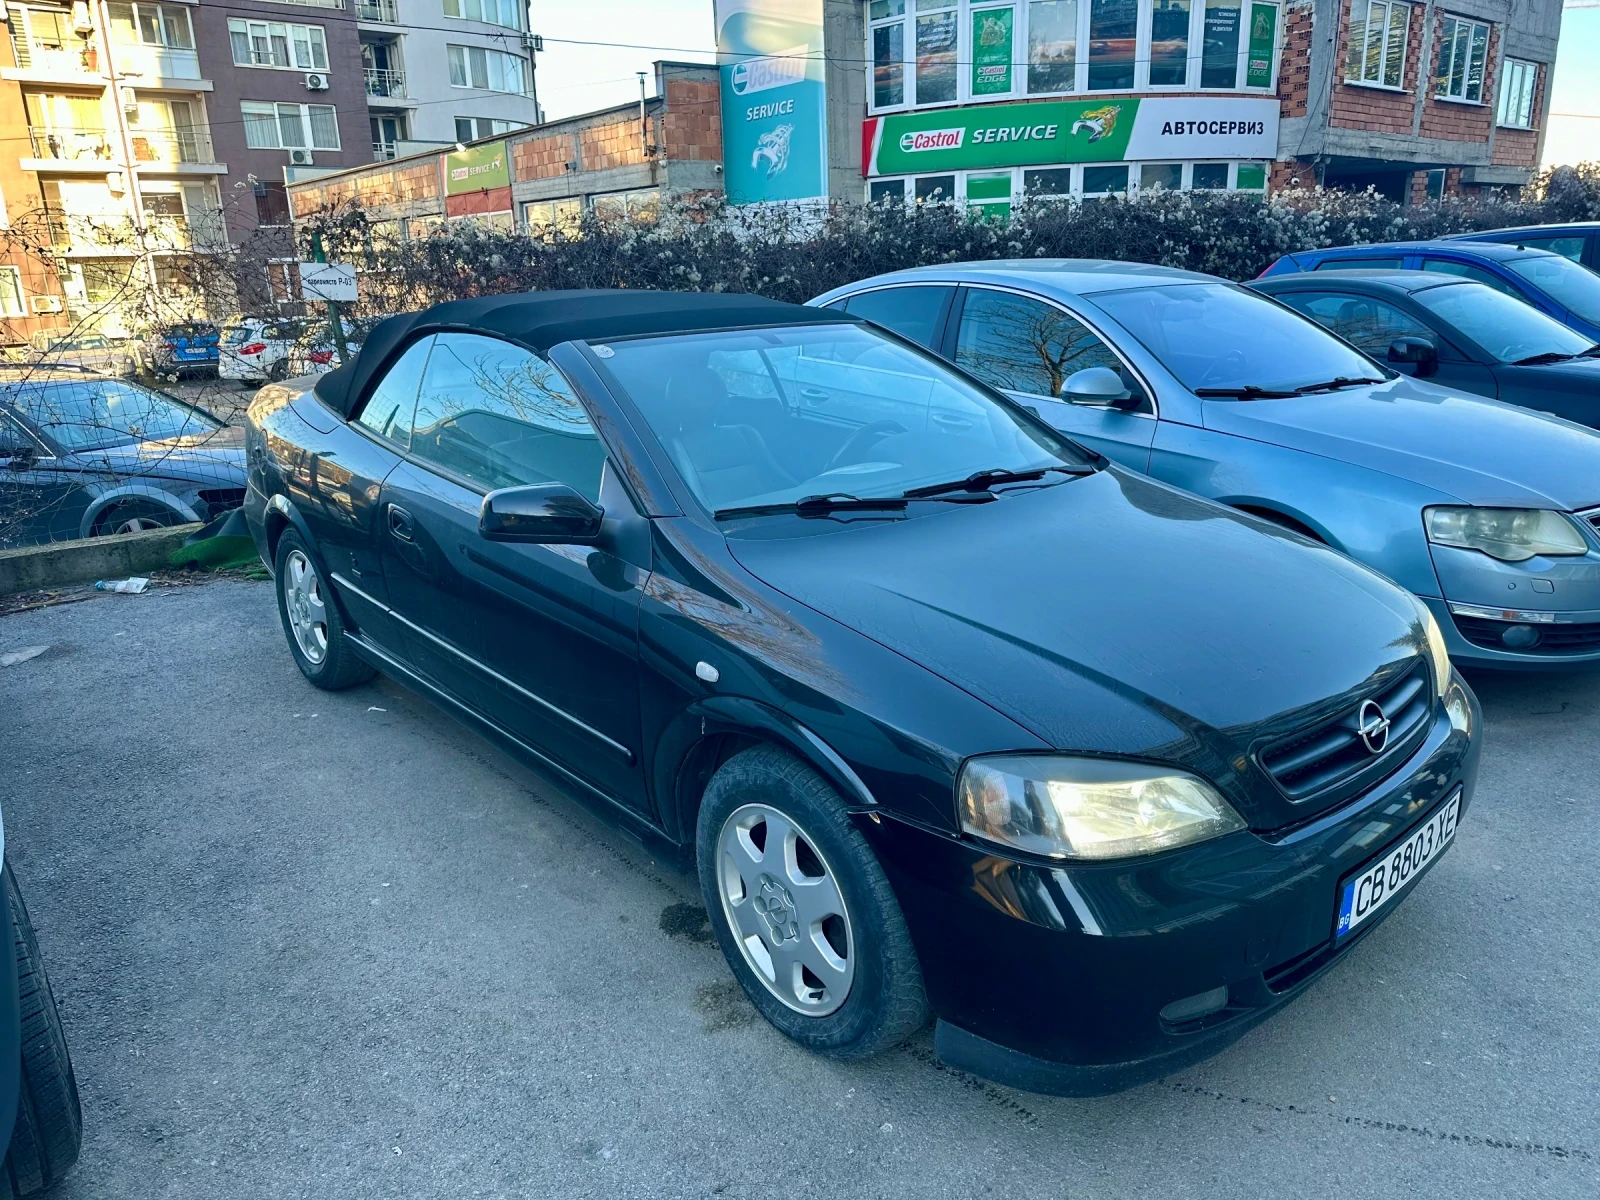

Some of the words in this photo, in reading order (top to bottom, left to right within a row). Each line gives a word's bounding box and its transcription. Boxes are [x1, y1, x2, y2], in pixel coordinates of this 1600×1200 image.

[984, 66, 1005, 74] Castrol
[977, 75, 1007, 83] EDGE
[746, 99, 795, 121] SERVICE
[1161, 121, 1264, 135] АВТОСЕРВИЗ
[914, 130, 961, 149] Castrol
[971, 124, 1059, 144] SERVICE
[469, 164, 490, 176] SERVICE
[1388, 823, 1434, 892] 8803
[1338, 913, 1350, 930] BG
